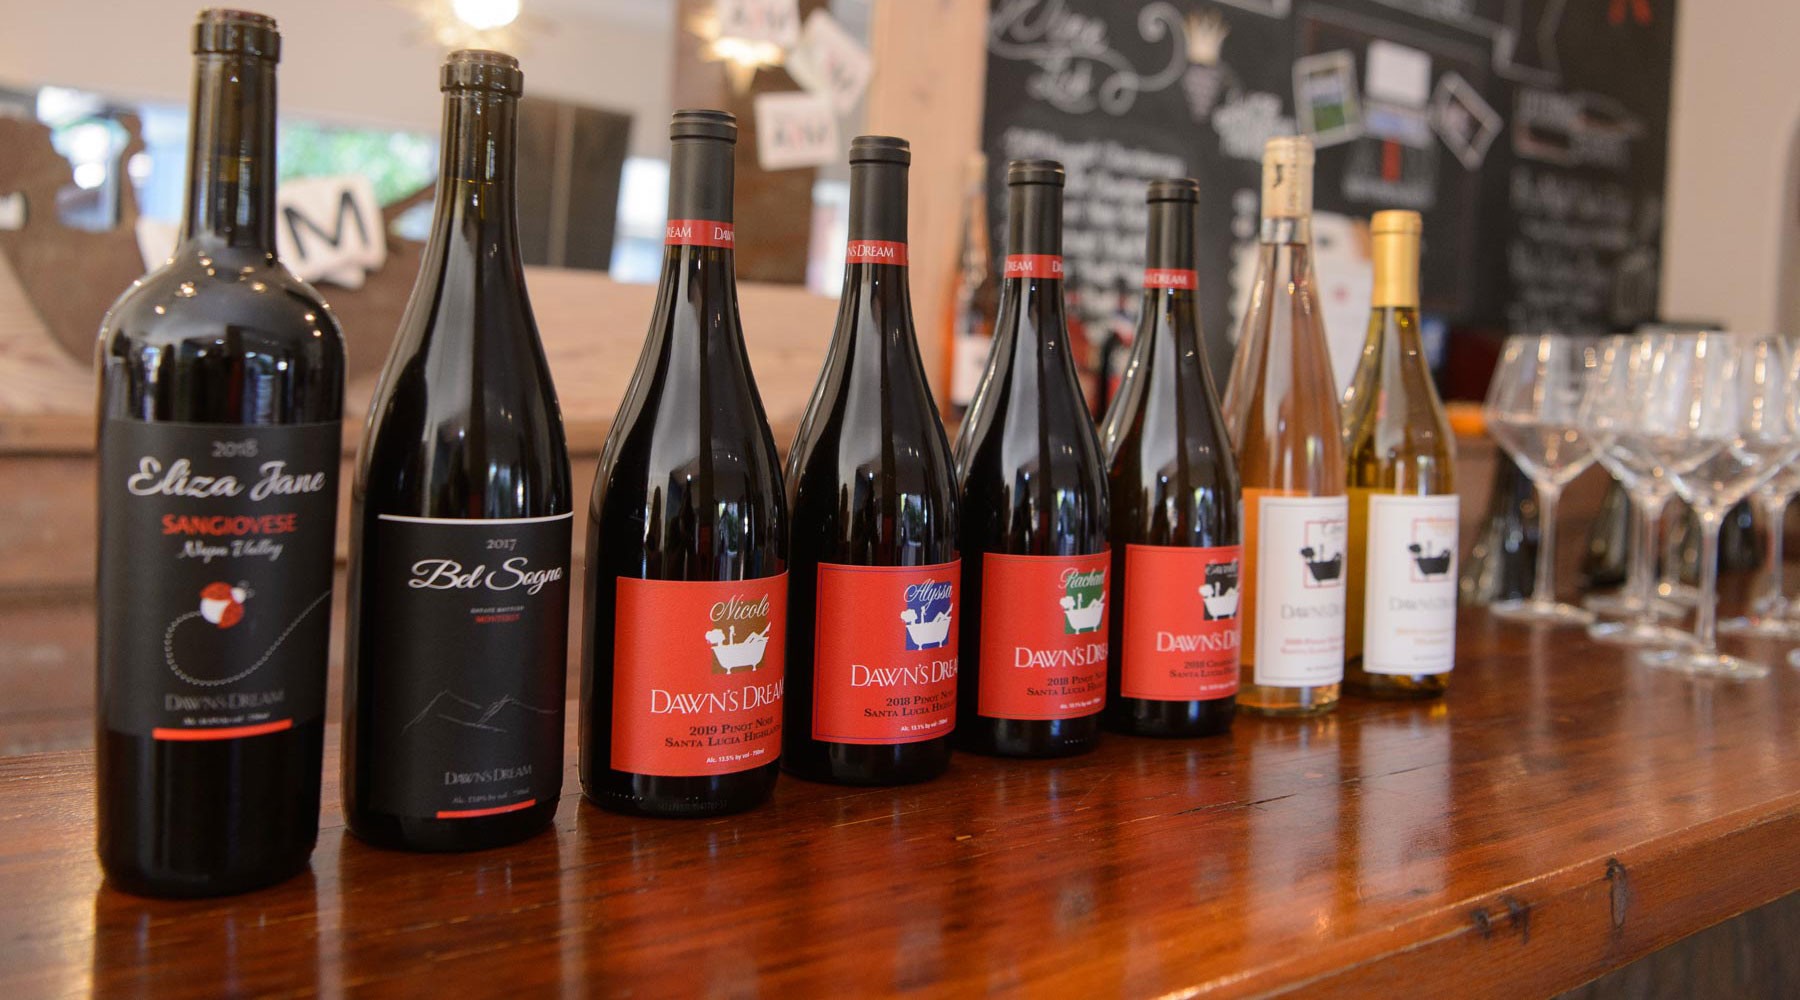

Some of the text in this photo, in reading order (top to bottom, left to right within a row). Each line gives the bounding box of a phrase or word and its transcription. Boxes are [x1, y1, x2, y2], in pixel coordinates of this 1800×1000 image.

[283, 188, 371, 261] M
[857, 244, 894, 258] DREAM
[127, 455, 326, 502] Eliza Jane
[161, 513, 298, 537] SANGIOVESE
[485, 538, 517, 552] 2017
[408, 556, 563, 596] Bel Sogno
[903, 578, 953, 610] Alyssa
[709, 592, 770, 622] Nicole
[1014, 646, 1085, 668] DAWN'S
[850, 663, 929, 687] DAWN'S
[650, 689, 739, 715] DAWN'S
[885, 697, 911, 707] 2018
[1026, 687, 1058, 697] SANTA
[863, 708, 898, 718] SANTA
[901, 706, 930, 717] LUCIA
[689, 725, 718, 736] 2019
[720, 720, 754, 735] PINOT
[665, 736, 703, 748] SANTA
[707, 735, 741, 747] LUCIA
